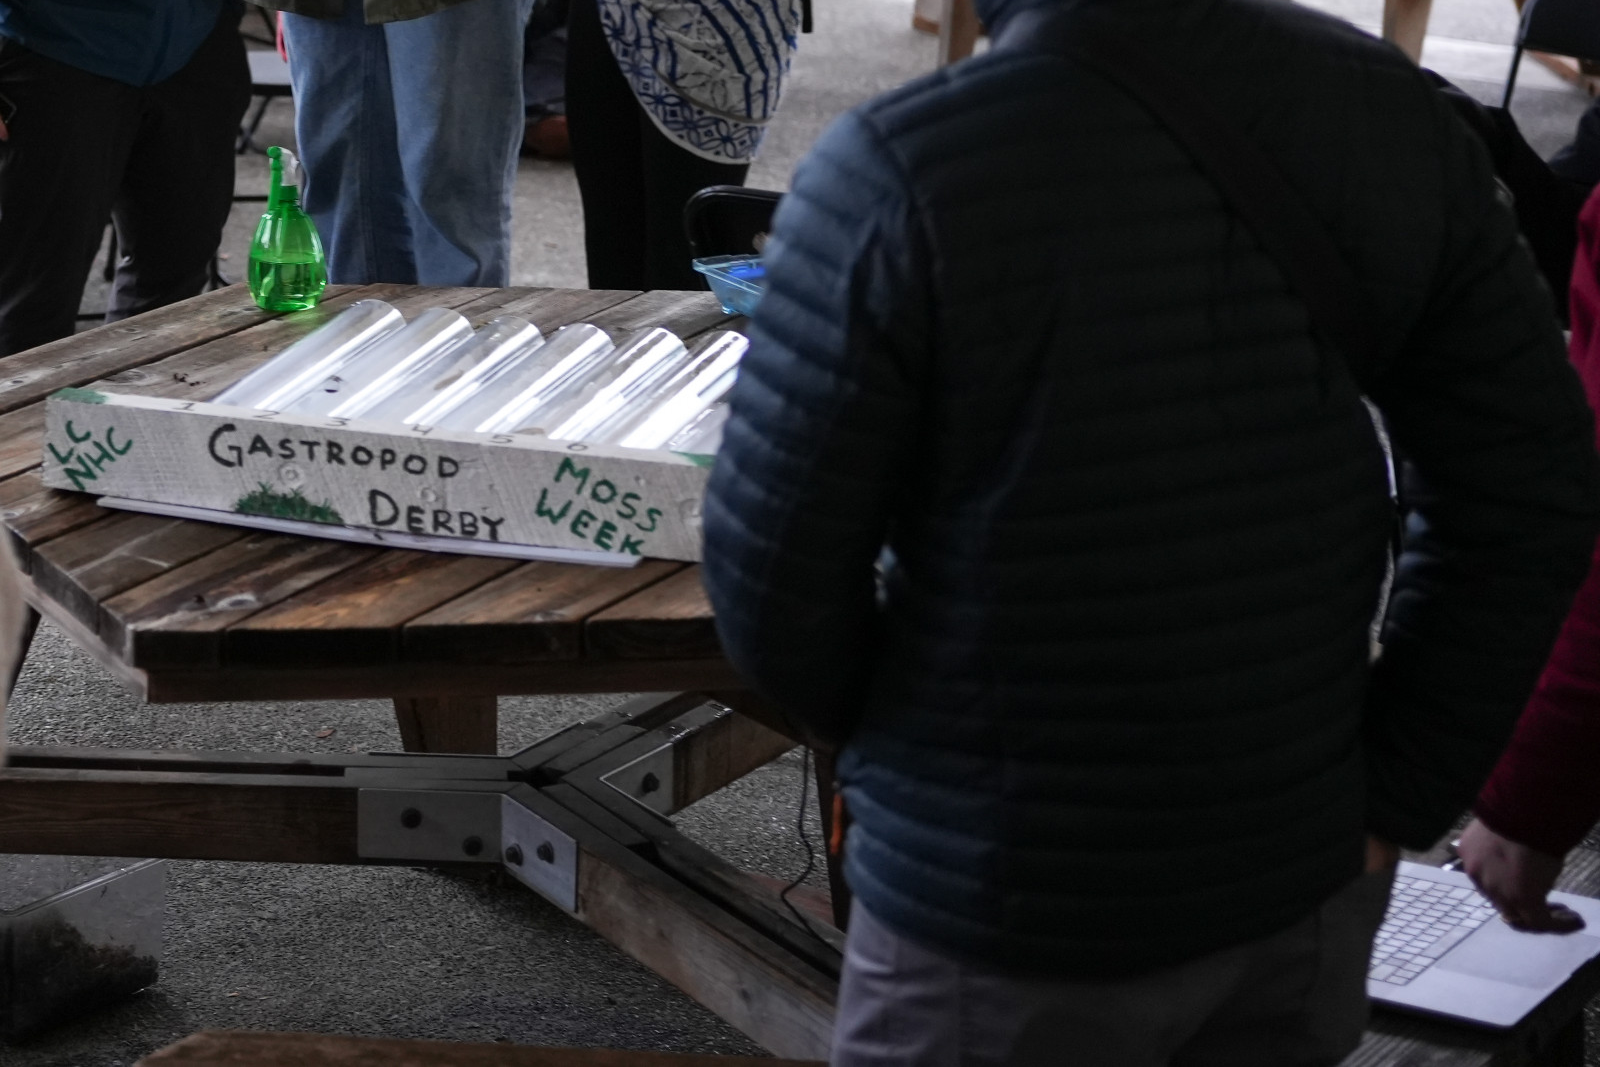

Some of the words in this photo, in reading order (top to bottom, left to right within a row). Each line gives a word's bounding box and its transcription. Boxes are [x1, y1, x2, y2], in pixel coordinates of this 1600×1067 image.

[173, 402, 196, 412] 1
[252, 409, 281, 420] 2
[325, 416, 350, 427] 3
[411, 422, 434, 436] 4
[490, 434, 515, 445] 5
[208, 423, 460, 478] GASTROPOD
[63, 426, 133, 492] NHC
[368, 488, 505, 541] DERBY
[534, 487, 646, 556] WEEK
[553, 456, 663, 533] MOSS
